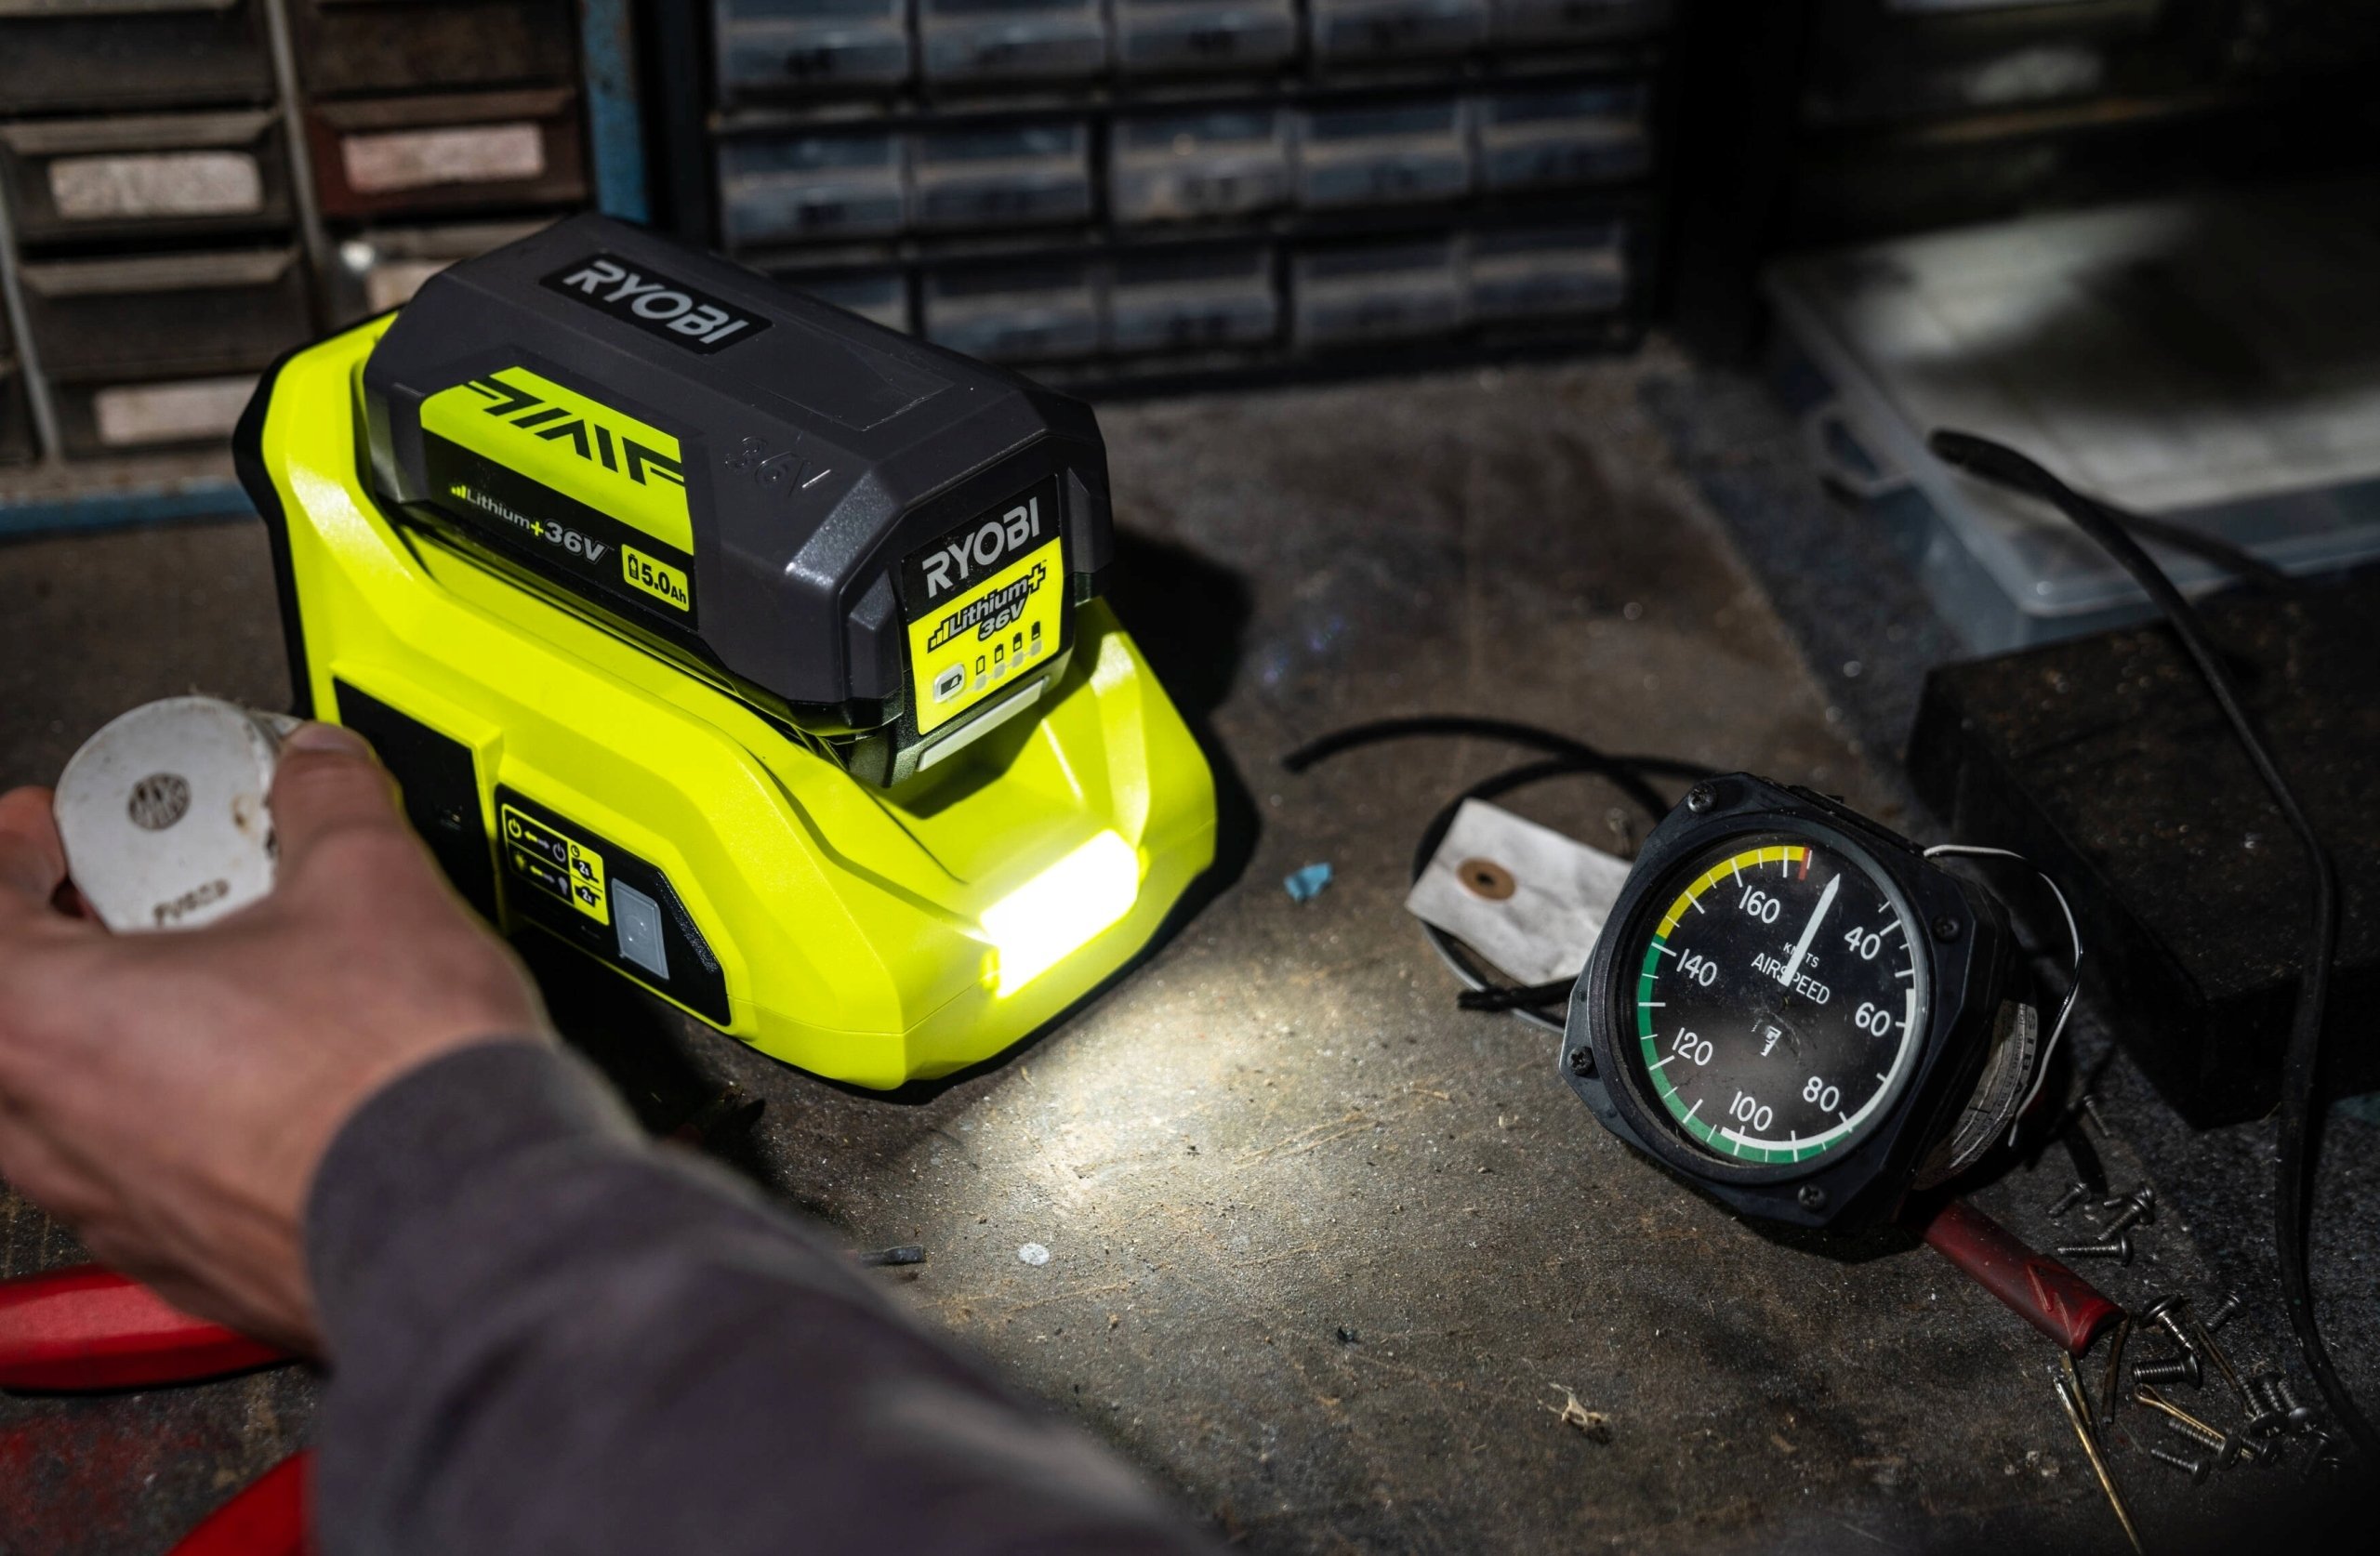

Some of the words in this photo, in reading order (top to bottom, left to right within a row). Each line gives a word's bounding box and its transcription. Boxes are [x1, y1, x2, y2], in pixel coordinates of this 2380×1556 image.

[562, 260, 748, 344] RYOBI
[921, 497, 1040, 598] RYOBI
[641, 564, 687, 604] 5.0Ah
[979, 600, 1027, 640] 36V
[1739, 886, 1780, 923] 160
[1844, 927, 1881, 960] 40
[1676, 949, 1718, 986] 140
[1855, 1002, 1890, 1036] 60
[1673, 1027, 1713, 1066] 120
[1729, 1091, 1773, 1131] 100
[1802, 1076, 1840, 1113] 80
